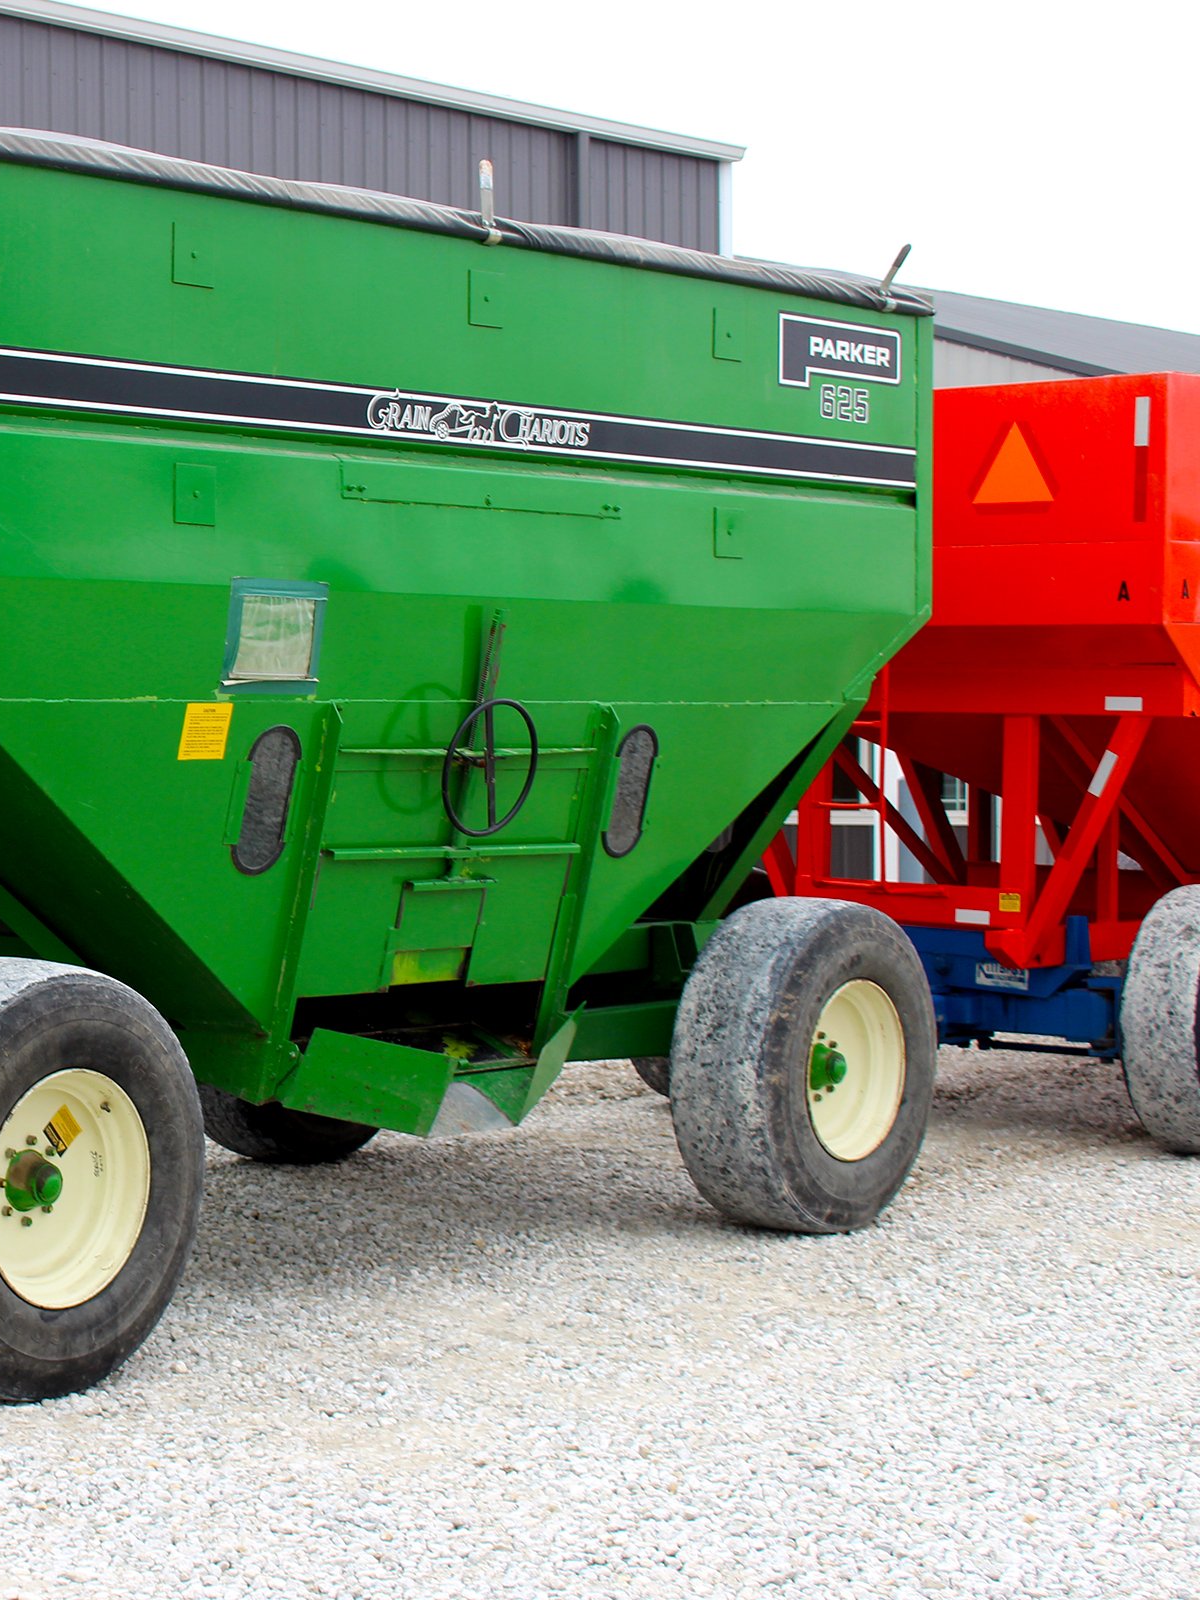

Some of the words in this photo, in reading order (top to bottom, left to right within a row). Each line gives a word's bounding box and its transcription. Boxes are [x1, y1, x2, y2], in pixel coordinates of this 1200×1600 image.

[809, 335, 891, 368] PARKER
[367, 388, 433, 431] GRAIN
[499, 409, 591, 451] CHARIOTS
[820, 384, 869, 424] 625
[1117, 580, 1130, 602] A
[1181, 579, 1190, 600] A
